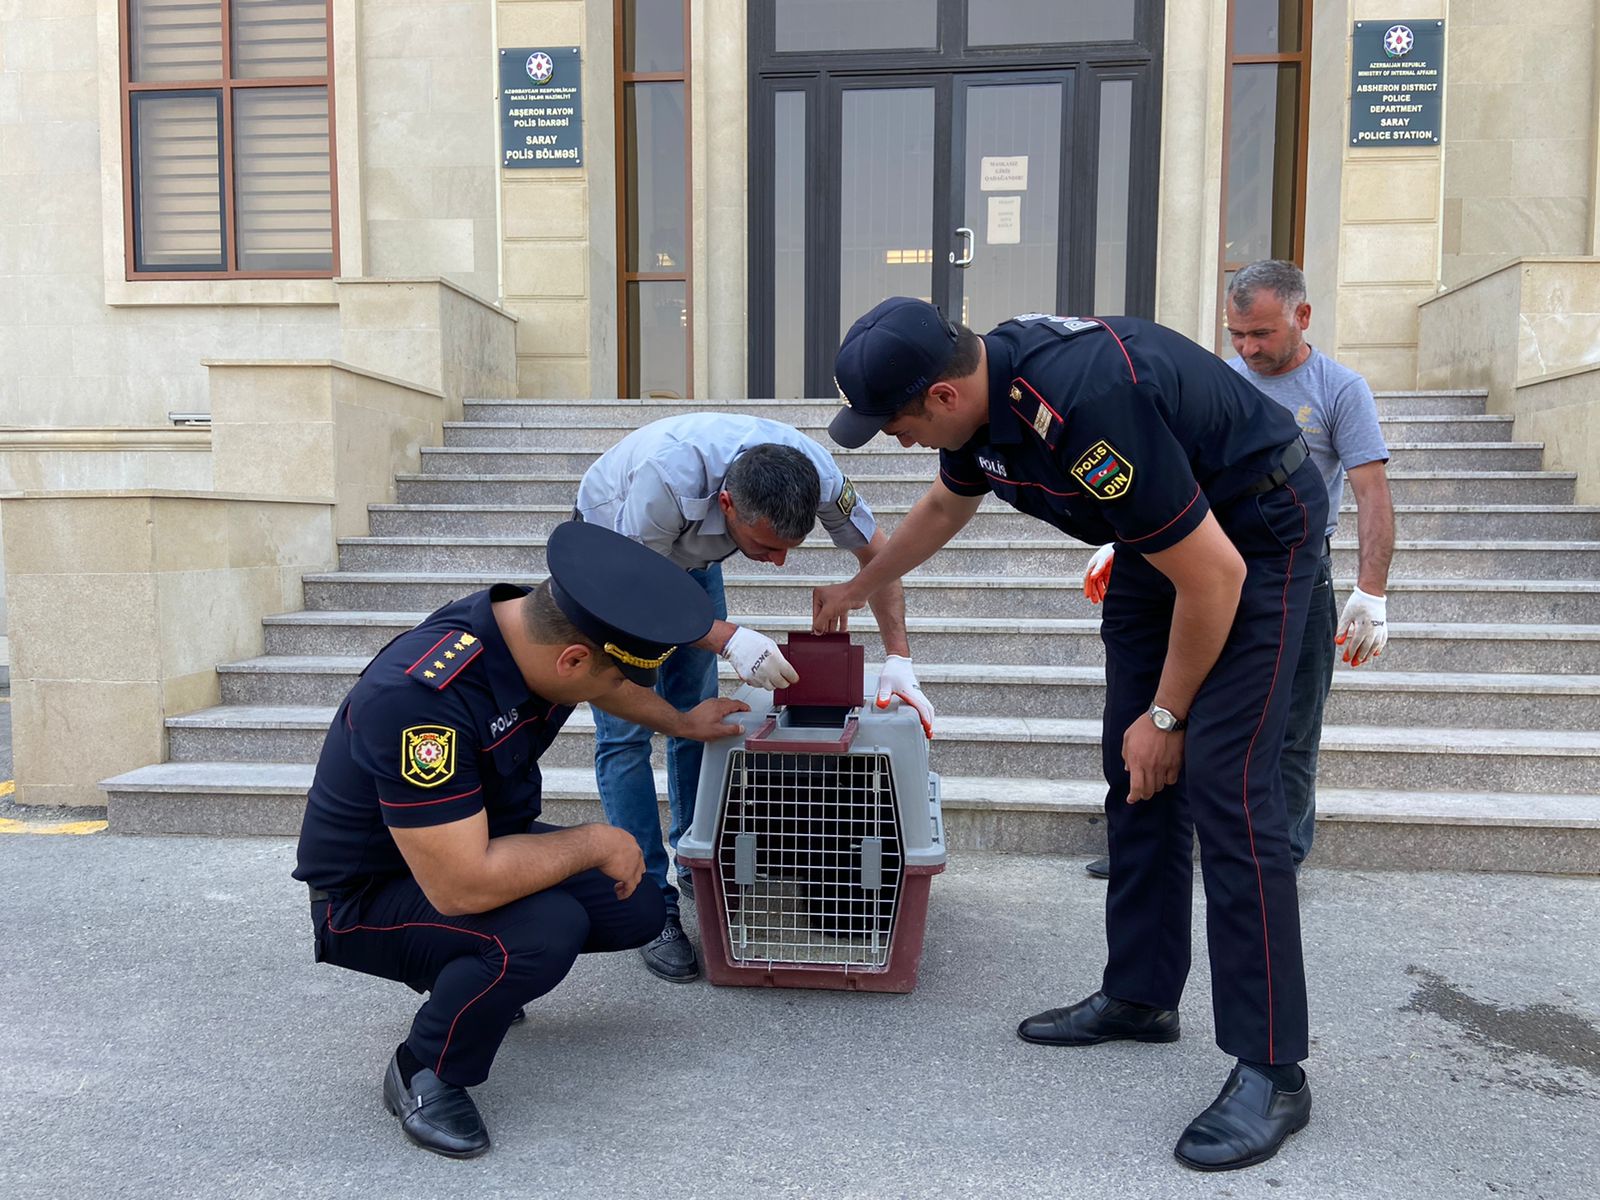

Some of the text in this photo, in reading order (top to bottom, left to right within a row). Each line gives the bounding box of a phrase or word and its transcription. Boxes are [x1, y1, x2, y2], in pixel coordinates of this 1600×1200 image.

[1356, 83, 1437, 92] ABSHERON DISTRICT
[1382, 94, 1411, 102] POLICE
[508, 107, 574, 117] ABŞERON RAYON
[1369, 104, 1423, 113] DEPARTMENT
[514, 117, 569, 127] POLİS İDARƏSİ
[1380, 118, 1410, 127] SARAY
[525, 135, 558, 145] SARAY
[1358, 130, 1432, 140] POLICE STATION
[506, 147, 578, 159] POLİS BÖLMƏSİ
